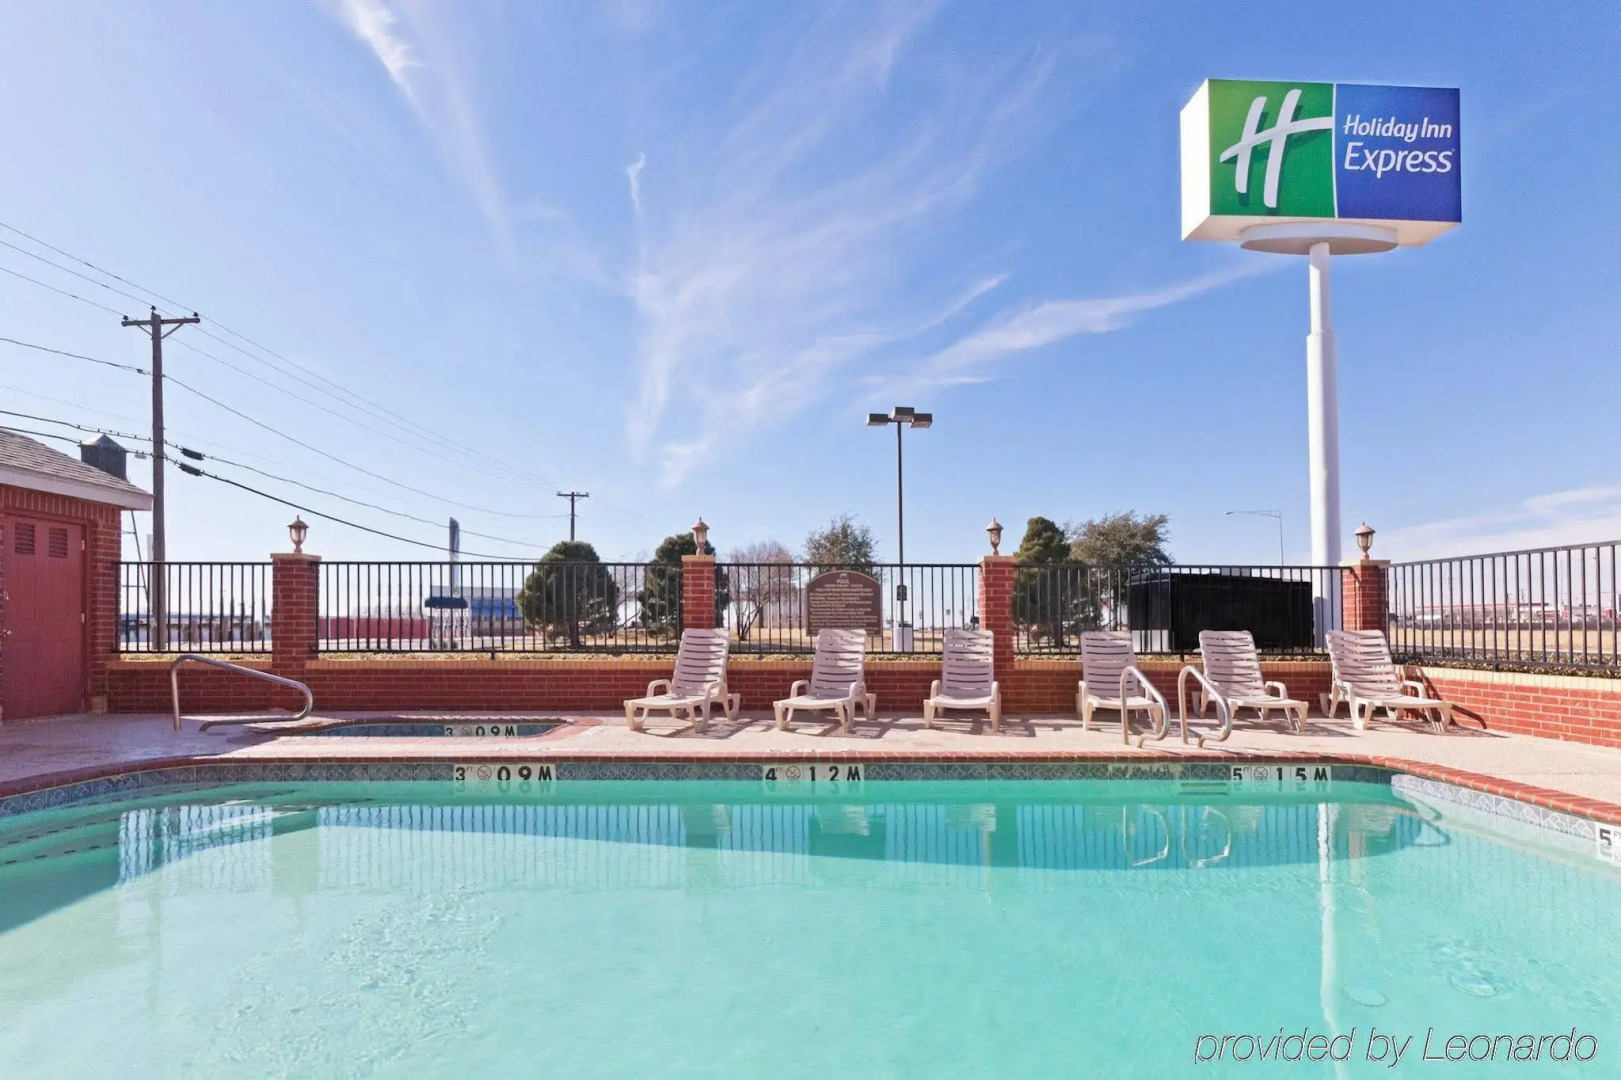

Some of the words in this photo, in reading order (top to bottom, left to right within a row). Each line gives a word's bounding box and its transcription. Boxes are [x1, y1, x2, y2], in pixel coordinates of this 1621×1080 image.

[1343, 114, 1418, 143] Holiday
[1421, 117, 1453, 138] Inn
[1344, 141, 1453, 179] Express
[455, 766, 466, 781] 3
[765, 767, 777, 781] 4
[1233, 767, 1243, 781] 5
[1599, 828, 1612, 846] 5
